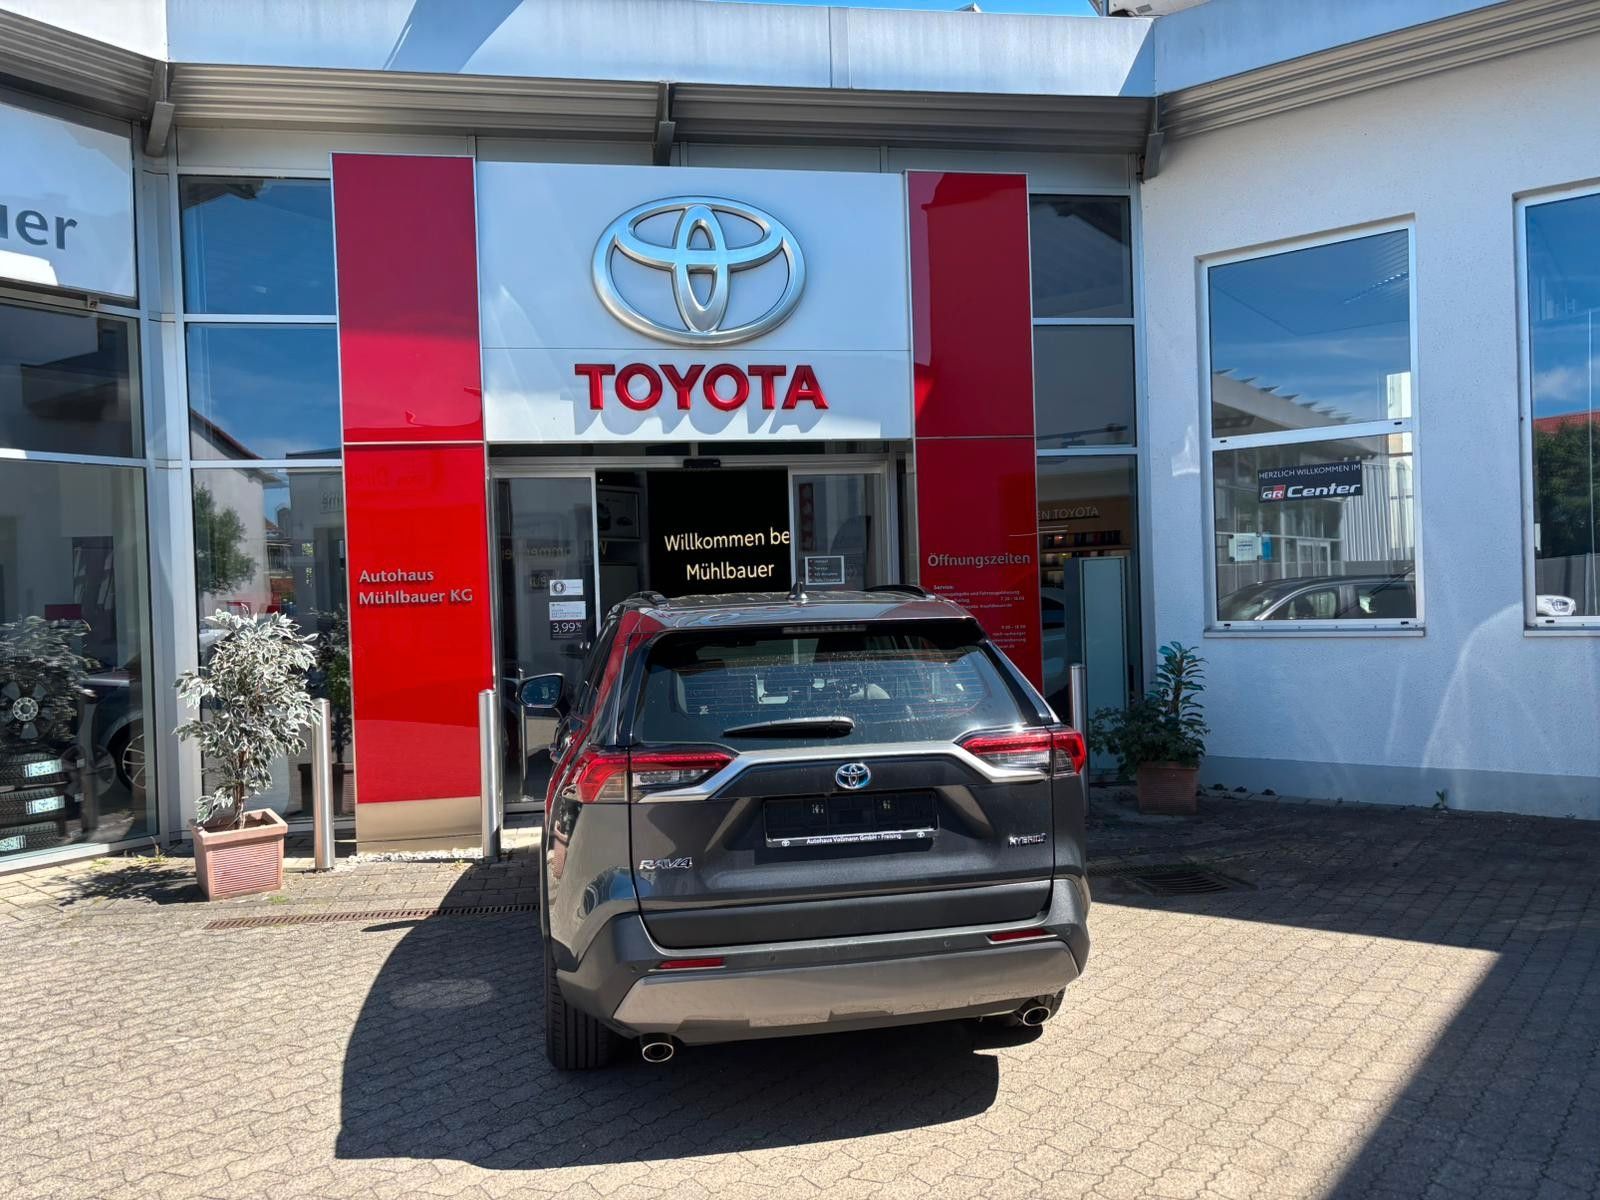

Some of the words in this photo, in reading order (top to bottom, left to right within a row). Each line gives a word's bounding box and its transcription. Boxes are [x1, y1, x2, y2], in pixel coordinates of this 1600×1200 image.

[574, 363, 829, 411] TOYOTA
[1259, 470, 1295, 480] HERZLICH
[1297, 464, 1349, 476] WILLKOMMEN
[1351, 463, 1361, 471] IM
[1262, 490, 1284, 499] GR
[1287, 482, 1361, 498] Center
[1054, 506, 1100, 519] TOYOTA
[664, 532, 765, 551] Willkommen
[927, 552, 1031, 568] Öffnungszeiten
[359, 568, 434, 583] Autohaus
[686, 561, 775, 580] Mühlbauer
[359, 589, 446, 605] Mühlbauer
[450, 588, 473, 602] KG
[806, 837, 832, 845] Autohaus
[860, 833, 877, 841] GmbH
[881, 832, 902, 841] Freising
[639, 857, 693, 870] RAV4
